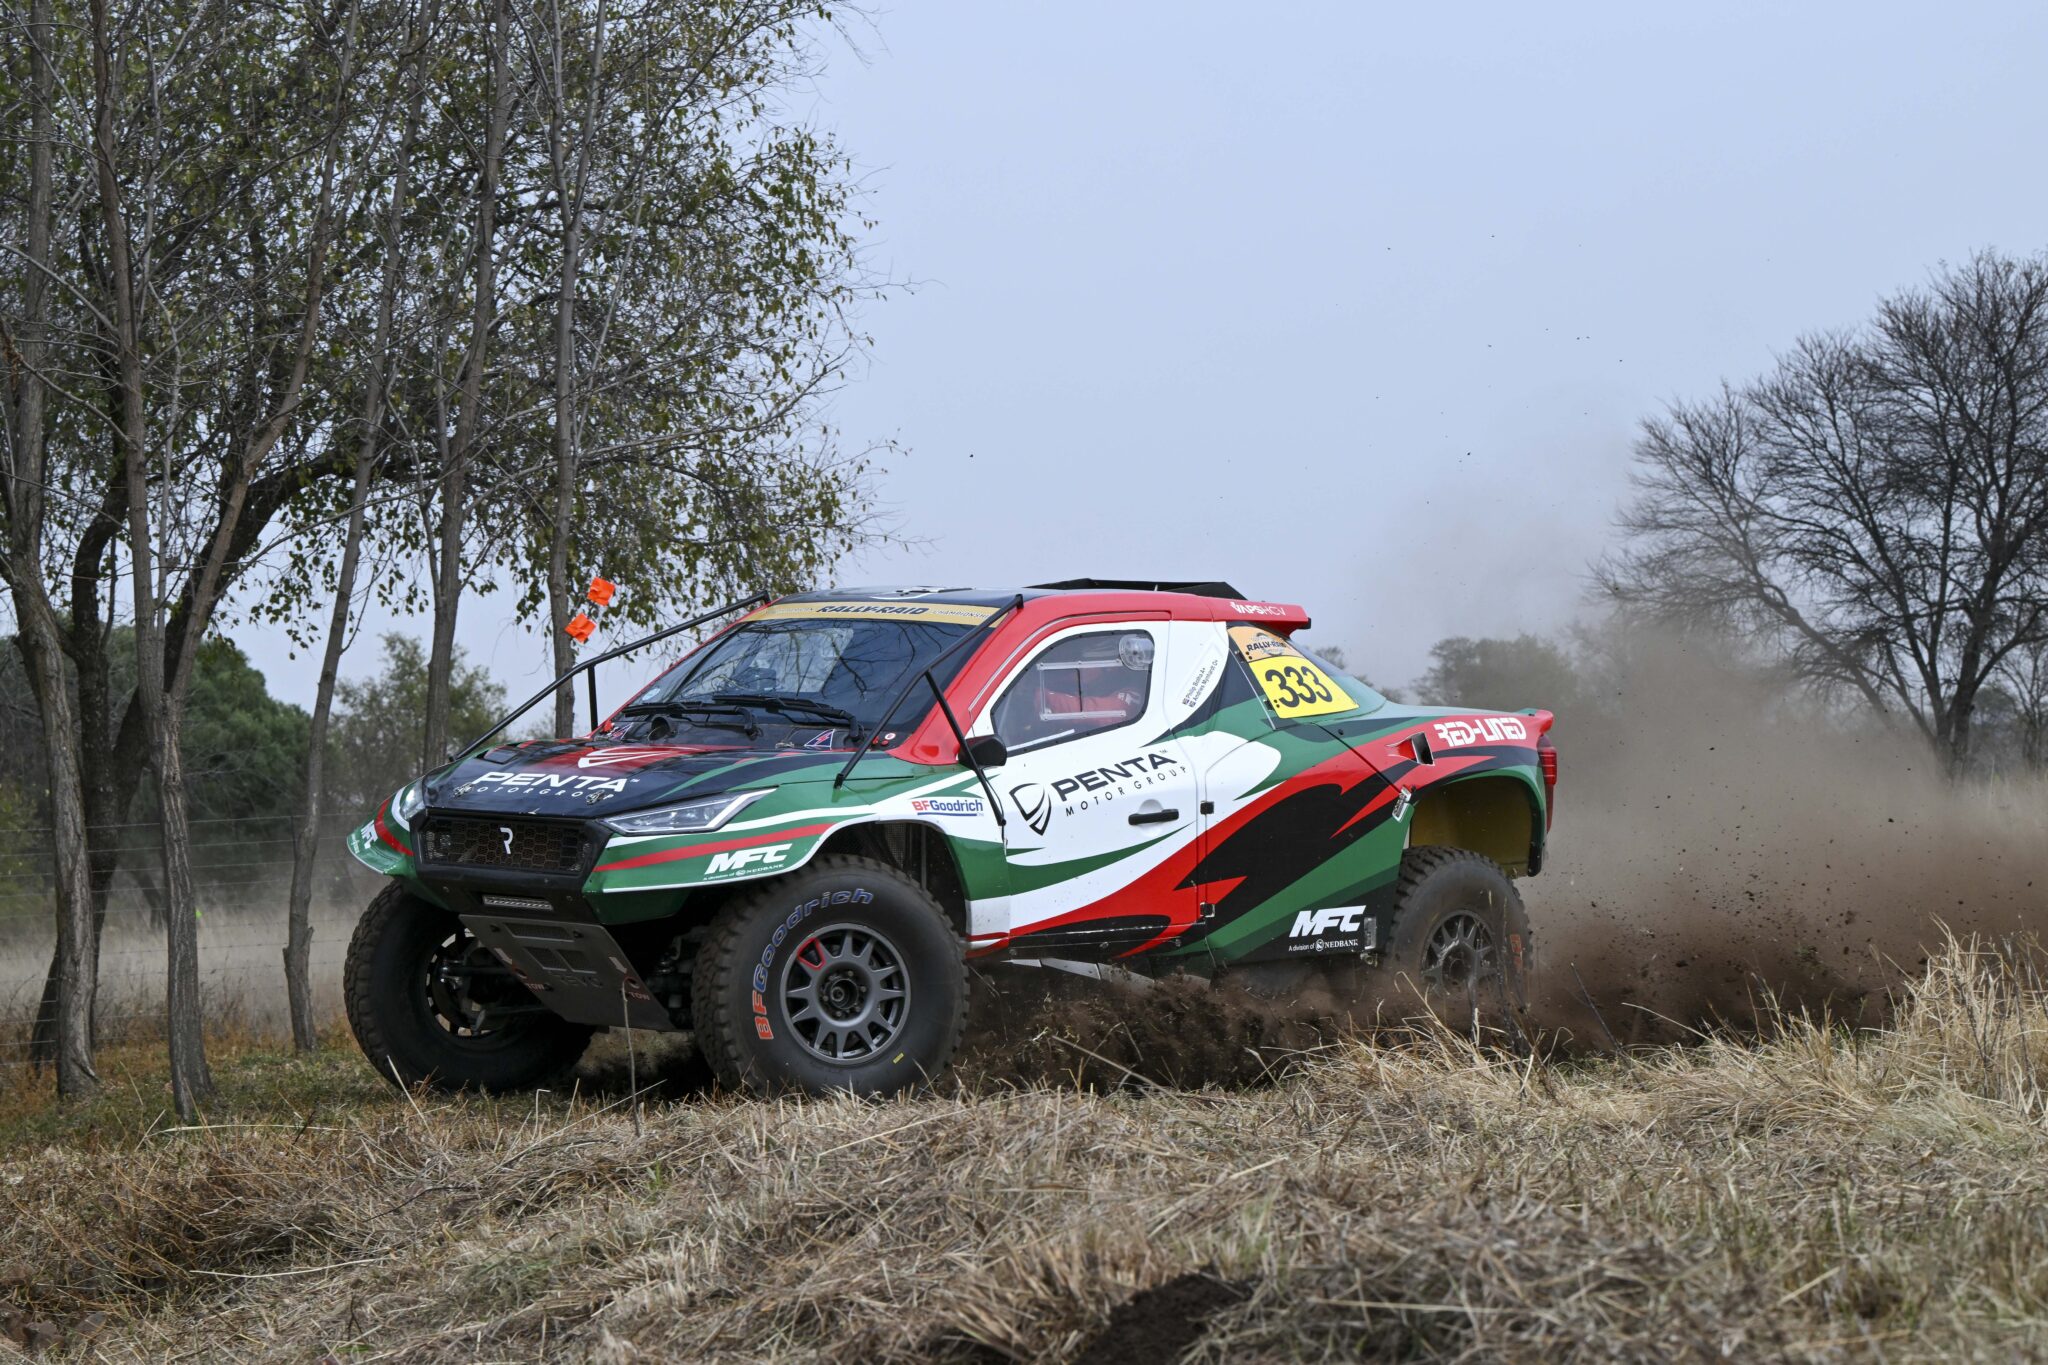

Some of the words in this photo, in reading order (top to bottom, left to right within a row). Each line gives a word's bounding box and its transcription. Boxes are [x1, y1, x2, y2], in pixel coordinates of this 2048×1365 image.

[817, 606, 929, 615] RALLY-RAID
[1265, 666, 1333, 708] 333
[1433, 717, 1527, 747] RED-LINED
[472, 771, 628, 792] PENTA
[1051, 753, 1178, 802] PENTA
[911, 799, 984, 812] BFGoodrich
[704, 843, 793, 875] MFC
[746, 864, 784, 873] NEDBANK
[1289, 905, 1367, 938] MFC
[1324, 939, 1359, 949] NEDBANK
[752, 888, 874, 1040] BFGoodrich
